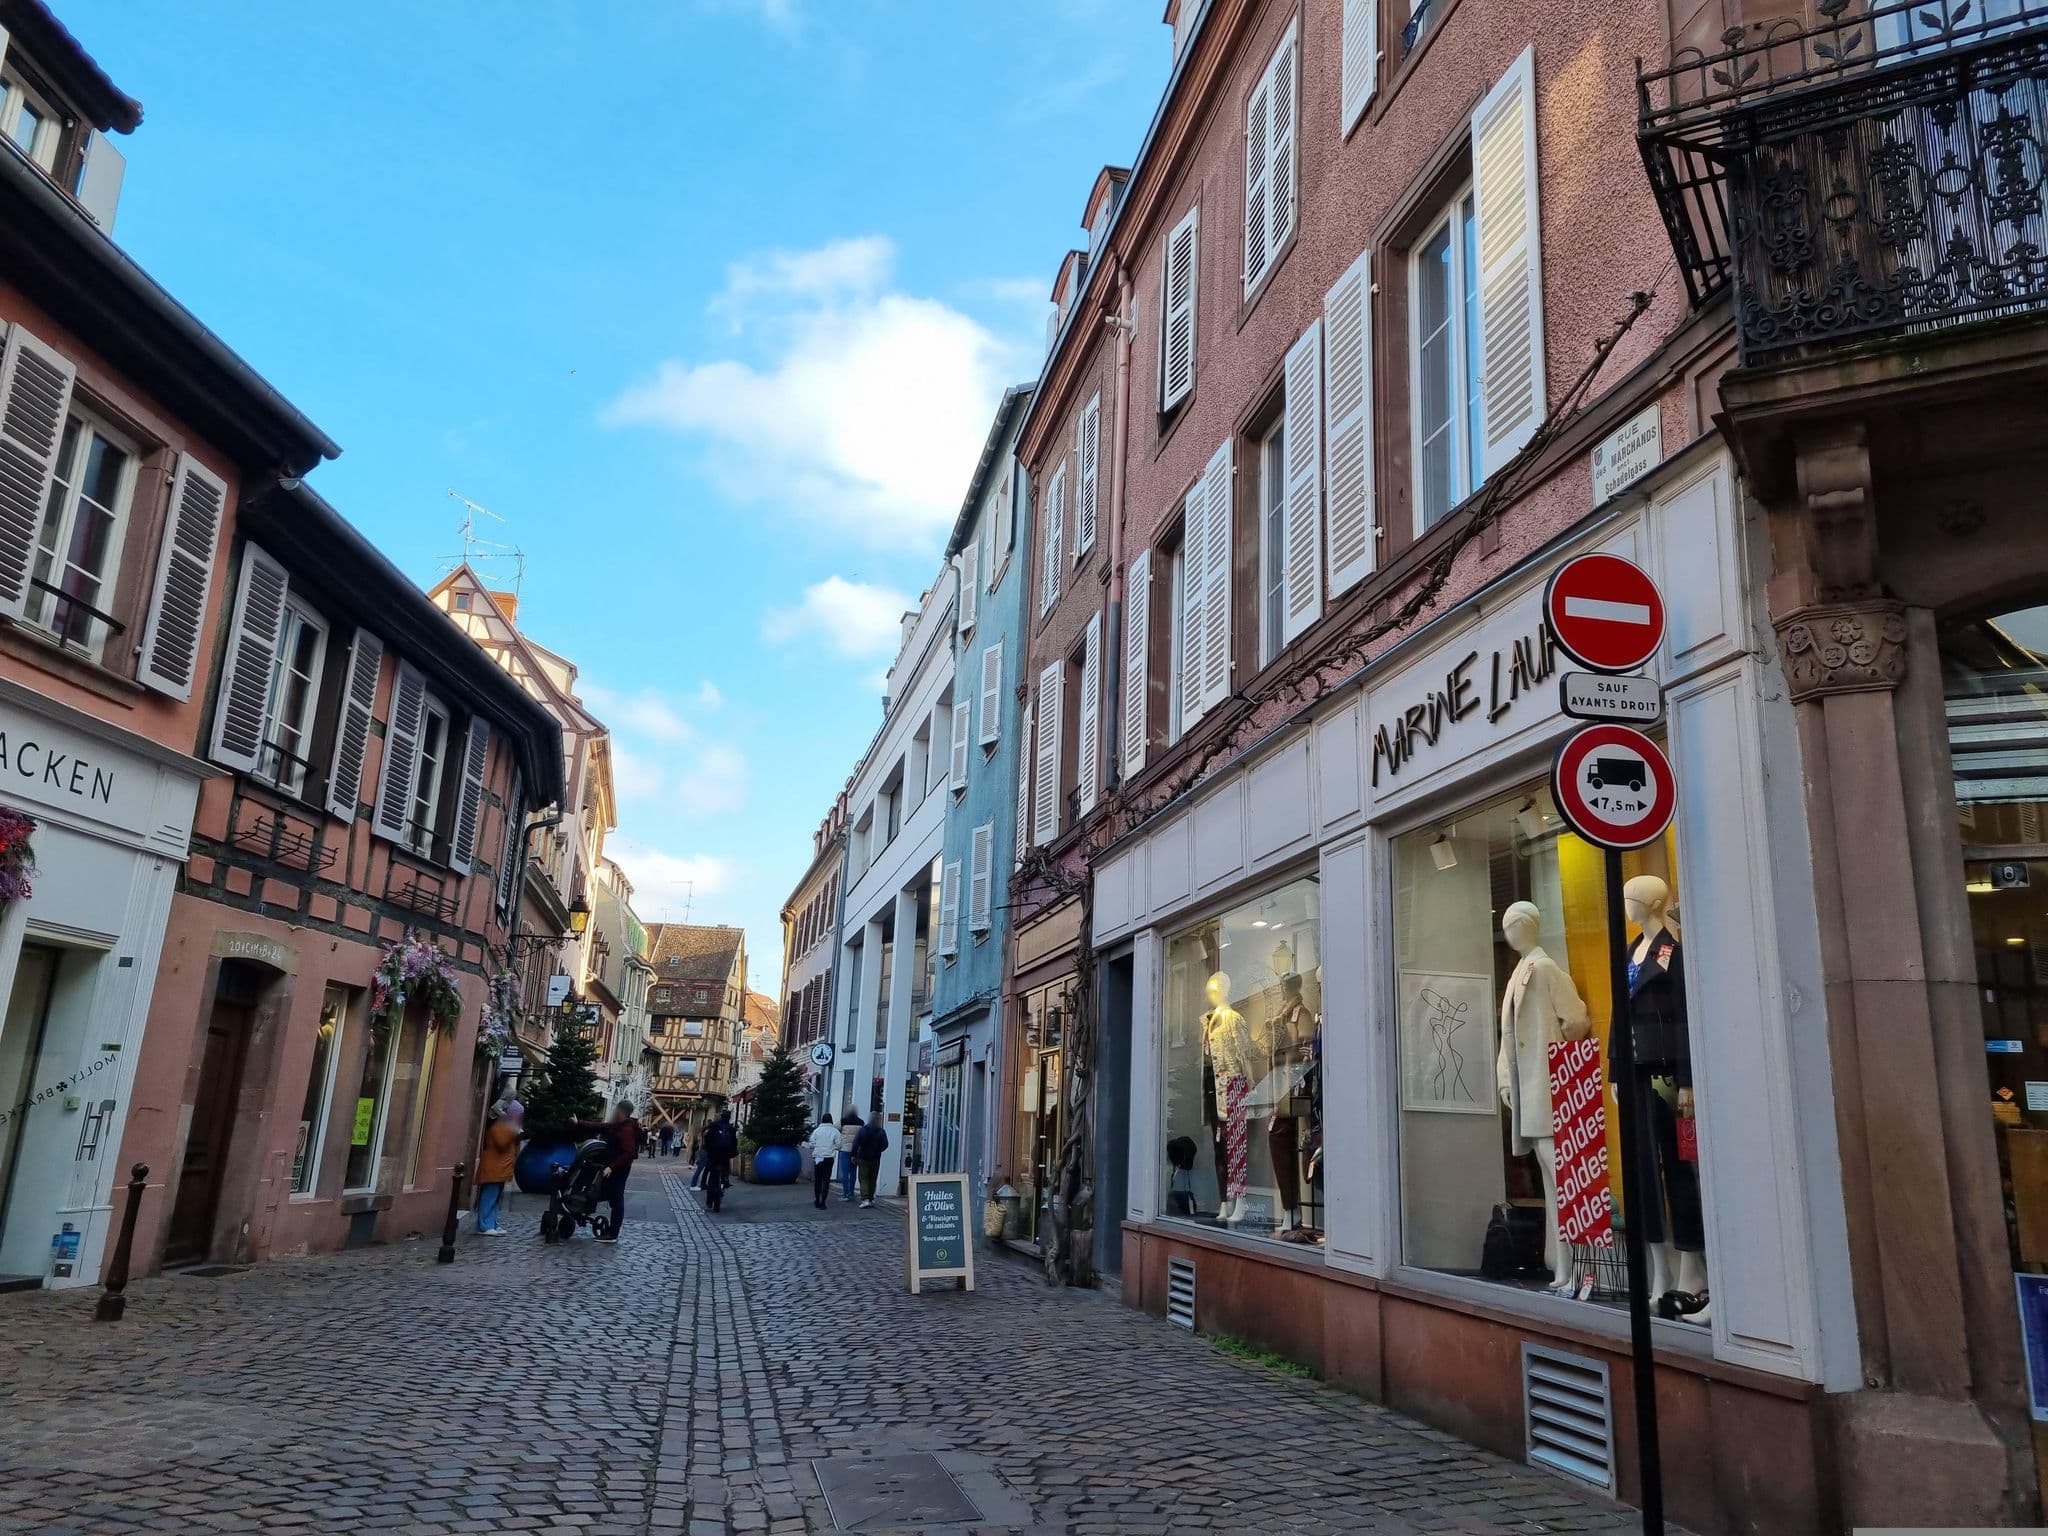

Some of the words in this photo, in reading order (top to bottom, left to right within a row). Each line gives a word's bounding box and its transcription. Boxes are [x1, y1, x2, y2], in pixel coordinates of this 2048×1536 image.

[1611, 425, 1657, 468] MARCHANDS
[1617, 422, 1639, 446] RUE
[1571, 696, 1617, 709] AYANTS
[1621, 701, 1657, 713] DROIT
[1597, 682, 1630, 694] SAUF
[1550, 1037, 1600, 1095] soldes
[1552, 1067, 1602, 1133] soldes
[1555, 1106, 1606, 1171] soldes
[924, 1190, 954, 1201] Huiles
[1556, 1146, 1609, 1210] soldes
[924, 1201, 955, 1211] d'Olive
[1559, 1186, 1612, 1243] soldes
